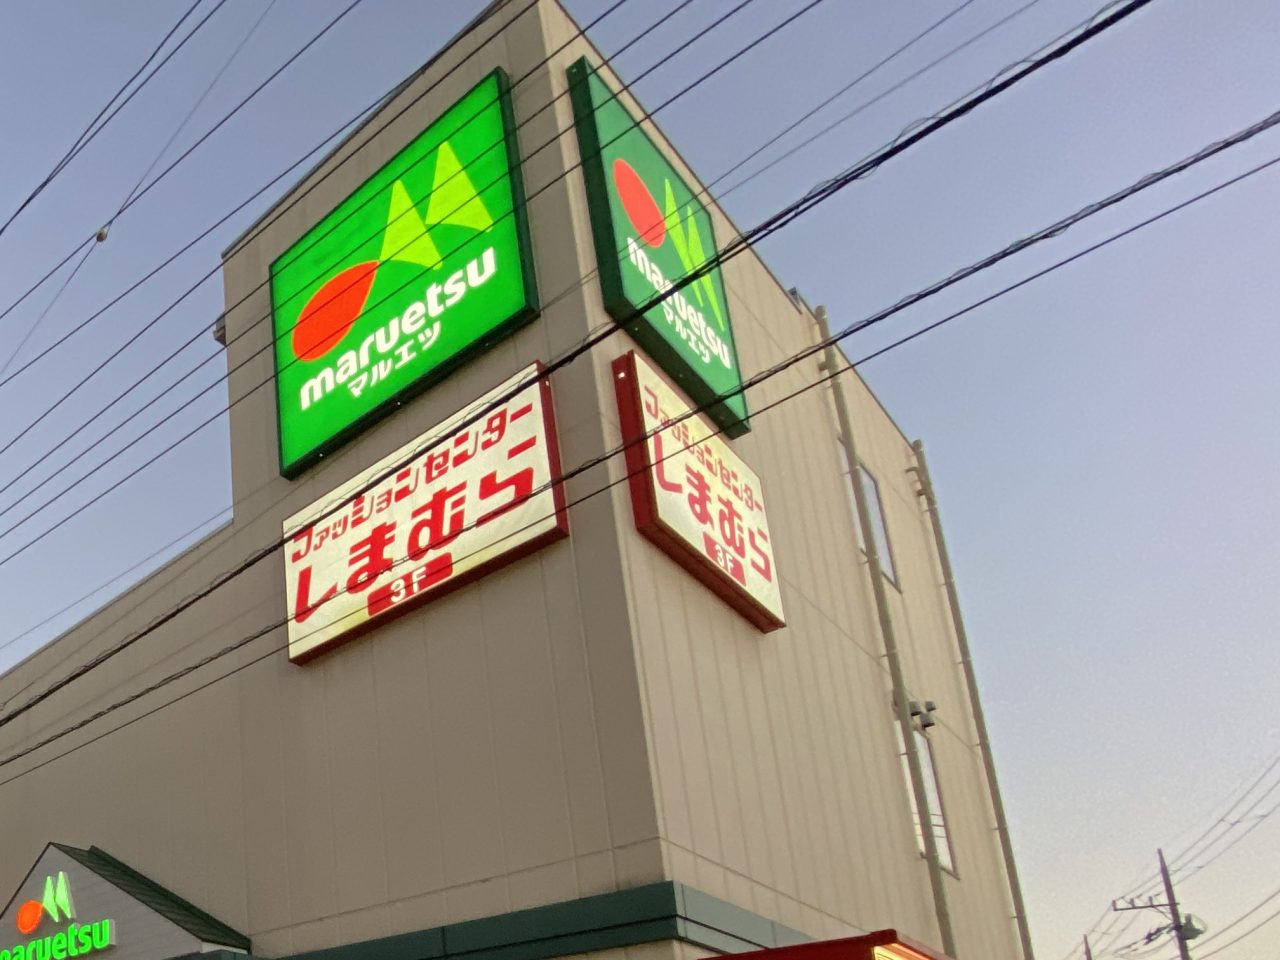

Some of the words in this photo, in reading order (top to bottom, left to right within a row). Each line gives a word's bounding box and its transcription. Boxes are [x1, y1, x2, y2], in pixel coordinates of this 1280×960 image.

[299, 247, 497, 412] maruetsu
[346, 320, 443, 400] マルエツ
[627, 237, 732, 370] maruetsu
[662, 300, 711, 364] マルエツ
[291, 403, 533, 563] ファッションセンター
[293, 437, 538, 624] しまむら
[654, 431, 772, 583] しまむら
[390, 565, 429, 604] 3F
[716, 544, 735, 573] 3F
